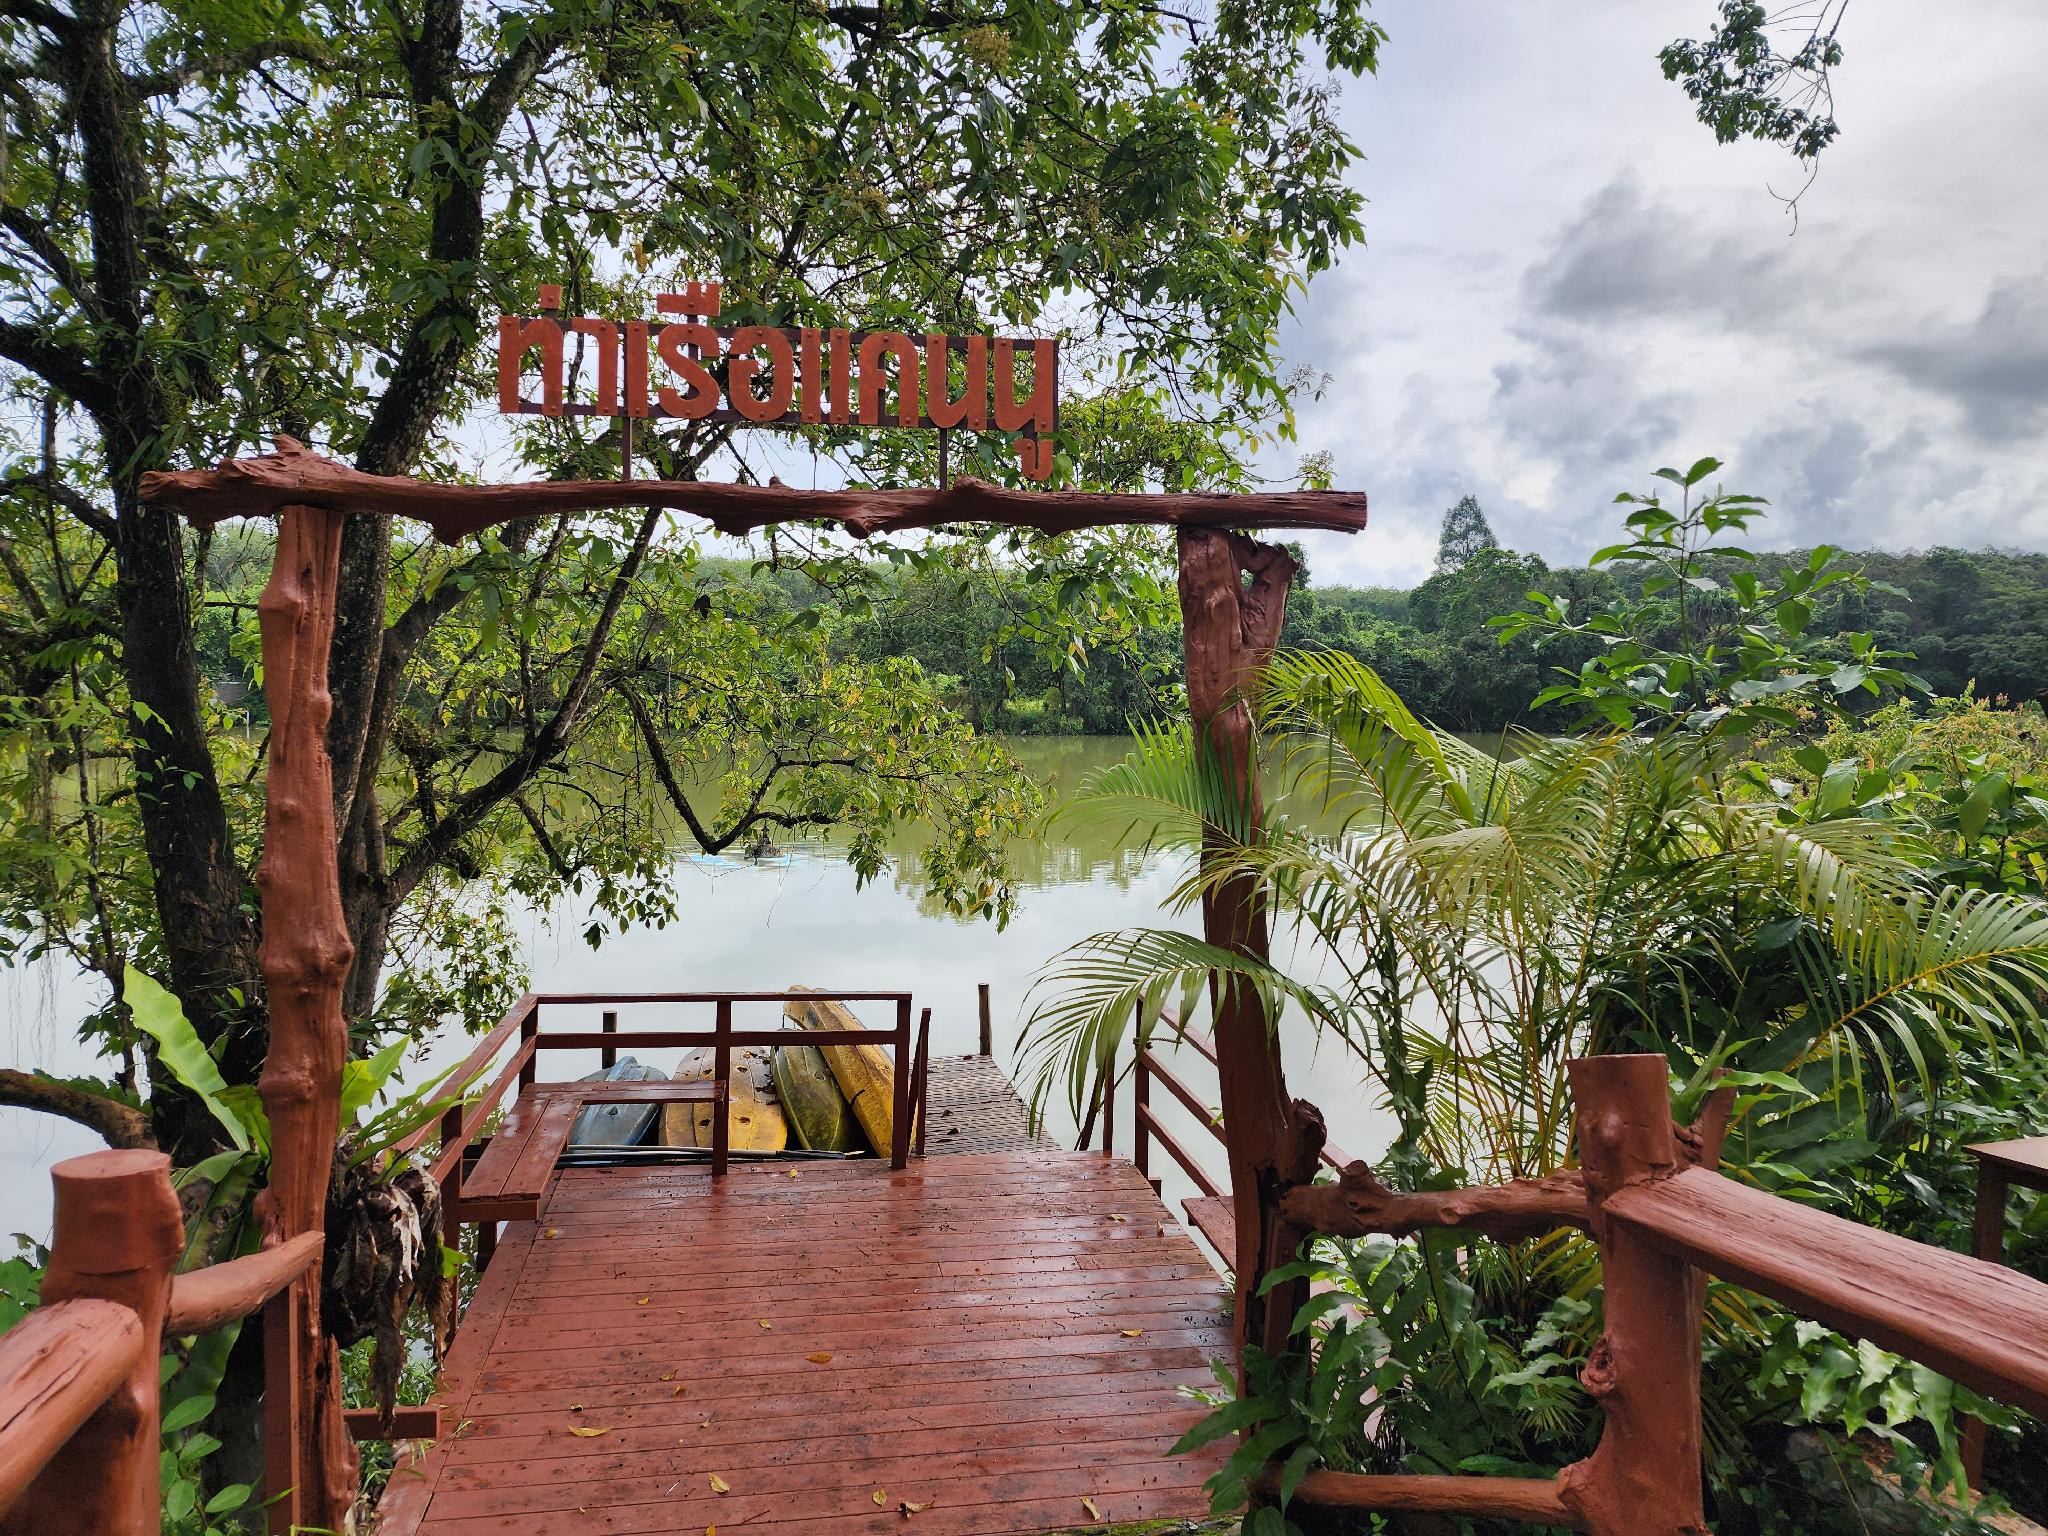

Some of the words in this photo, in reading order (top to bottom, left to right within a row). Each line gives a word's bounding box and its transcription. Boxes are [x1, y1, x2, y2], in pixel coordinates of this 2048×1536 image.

[499, 281, 1056, 481] ท่าเรือแคนนู
